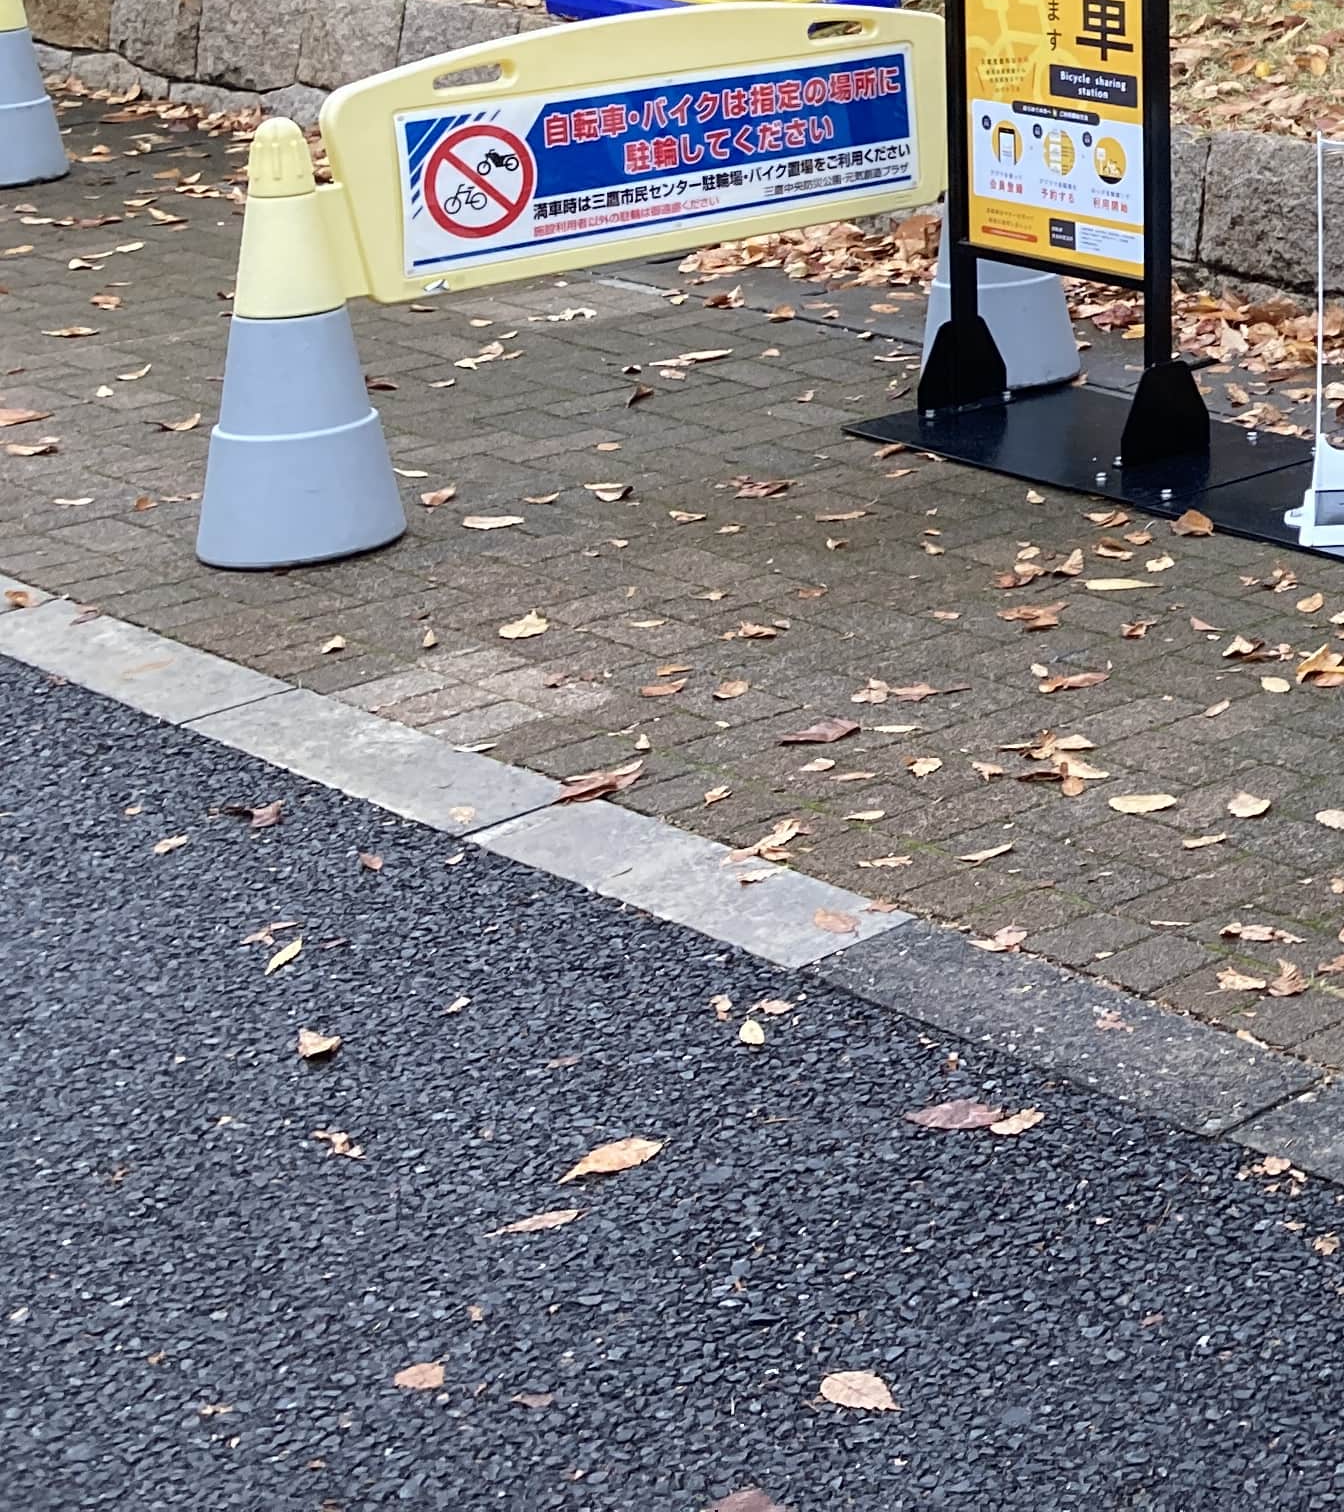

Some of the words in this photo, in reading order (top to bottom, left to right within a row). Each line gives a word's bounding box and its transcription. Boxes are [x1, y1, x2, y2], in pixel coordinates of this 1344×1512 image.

[1060, 70, 1091, 85] Bicycle
[1095, 77, 1127, 92] sharing
[1078, 87, 1109, 99] station
[544, 66, 902, 148] 自転車・バイクは指定の場所に
[624, 115, 834, 175] 駐輪してください
